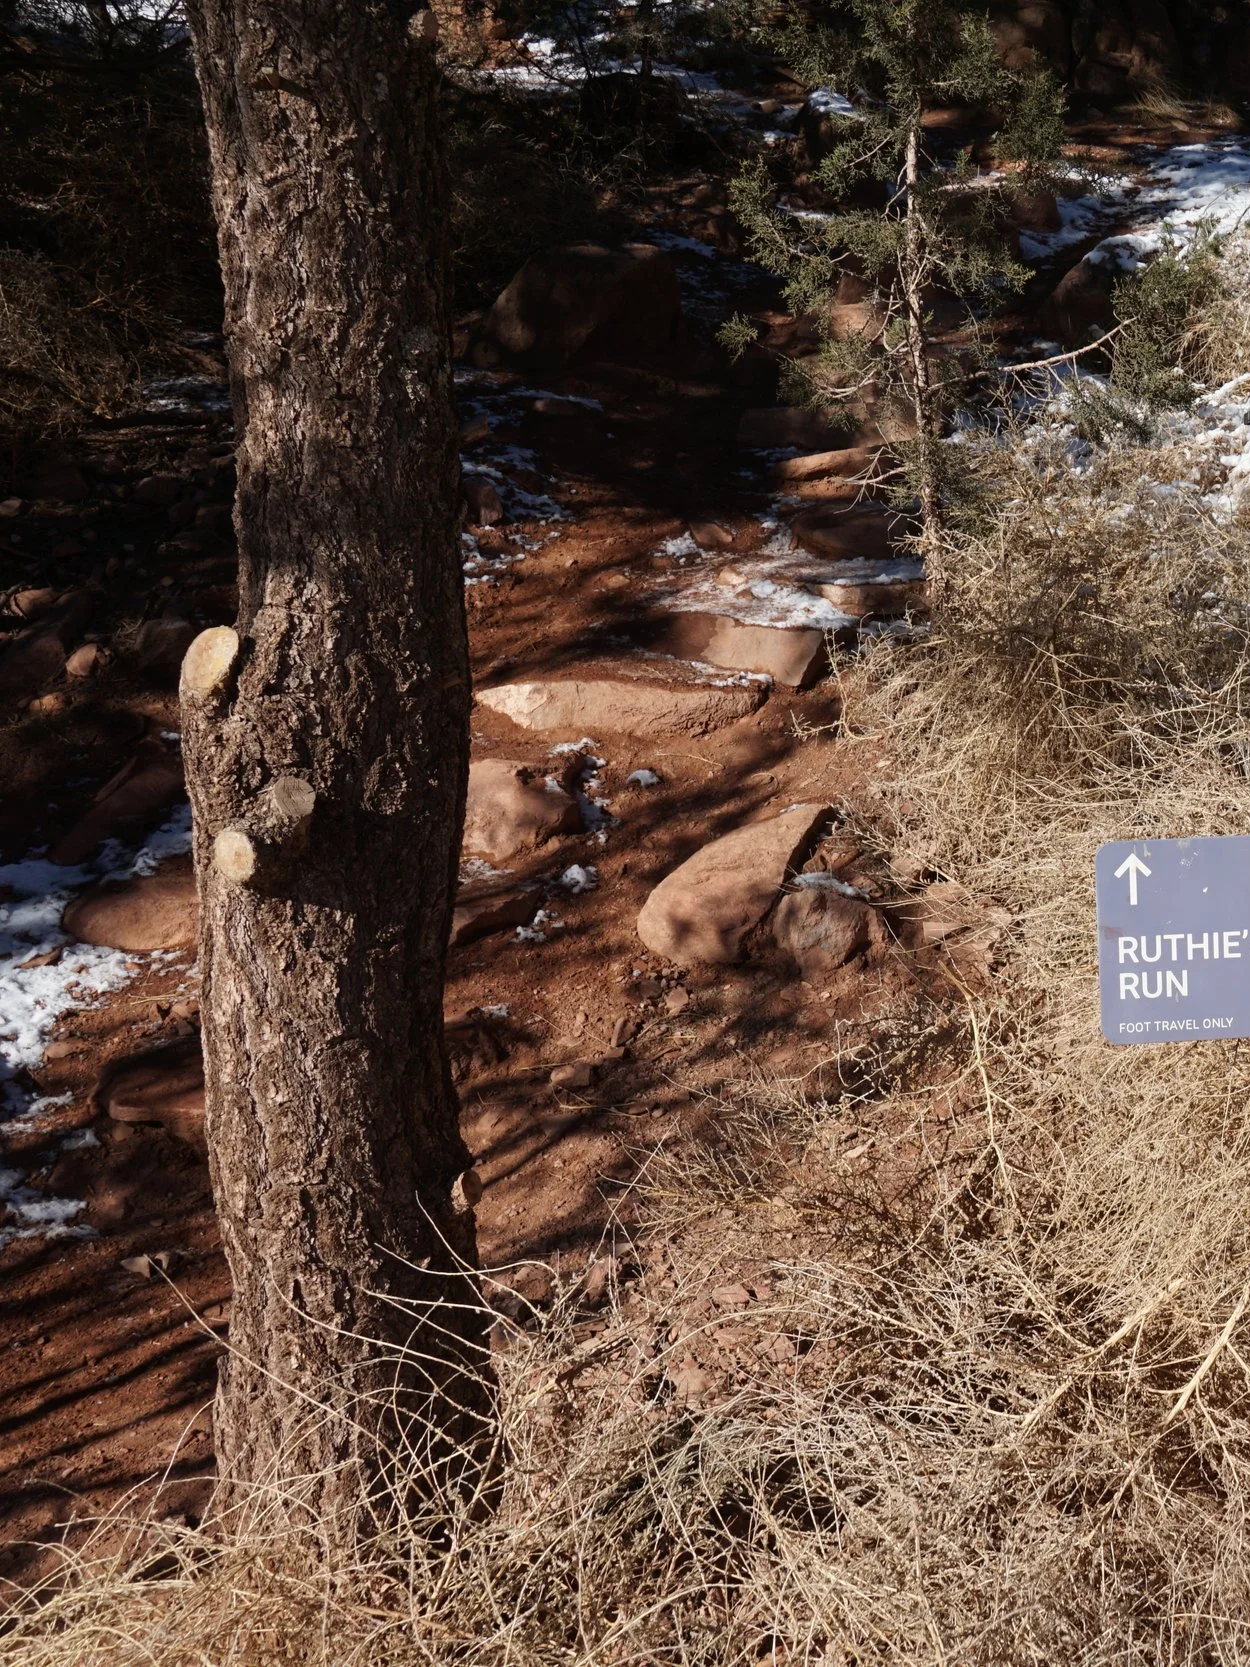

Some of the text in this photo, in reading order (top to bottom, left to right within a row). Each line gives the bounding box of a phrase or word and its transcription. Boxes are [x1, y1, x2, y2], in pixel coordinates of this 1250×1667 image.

[1119, 969, 1189, 1000] RUN
[1119, 1017, 1234, 1034] FOOT TRAVEL ONLY
